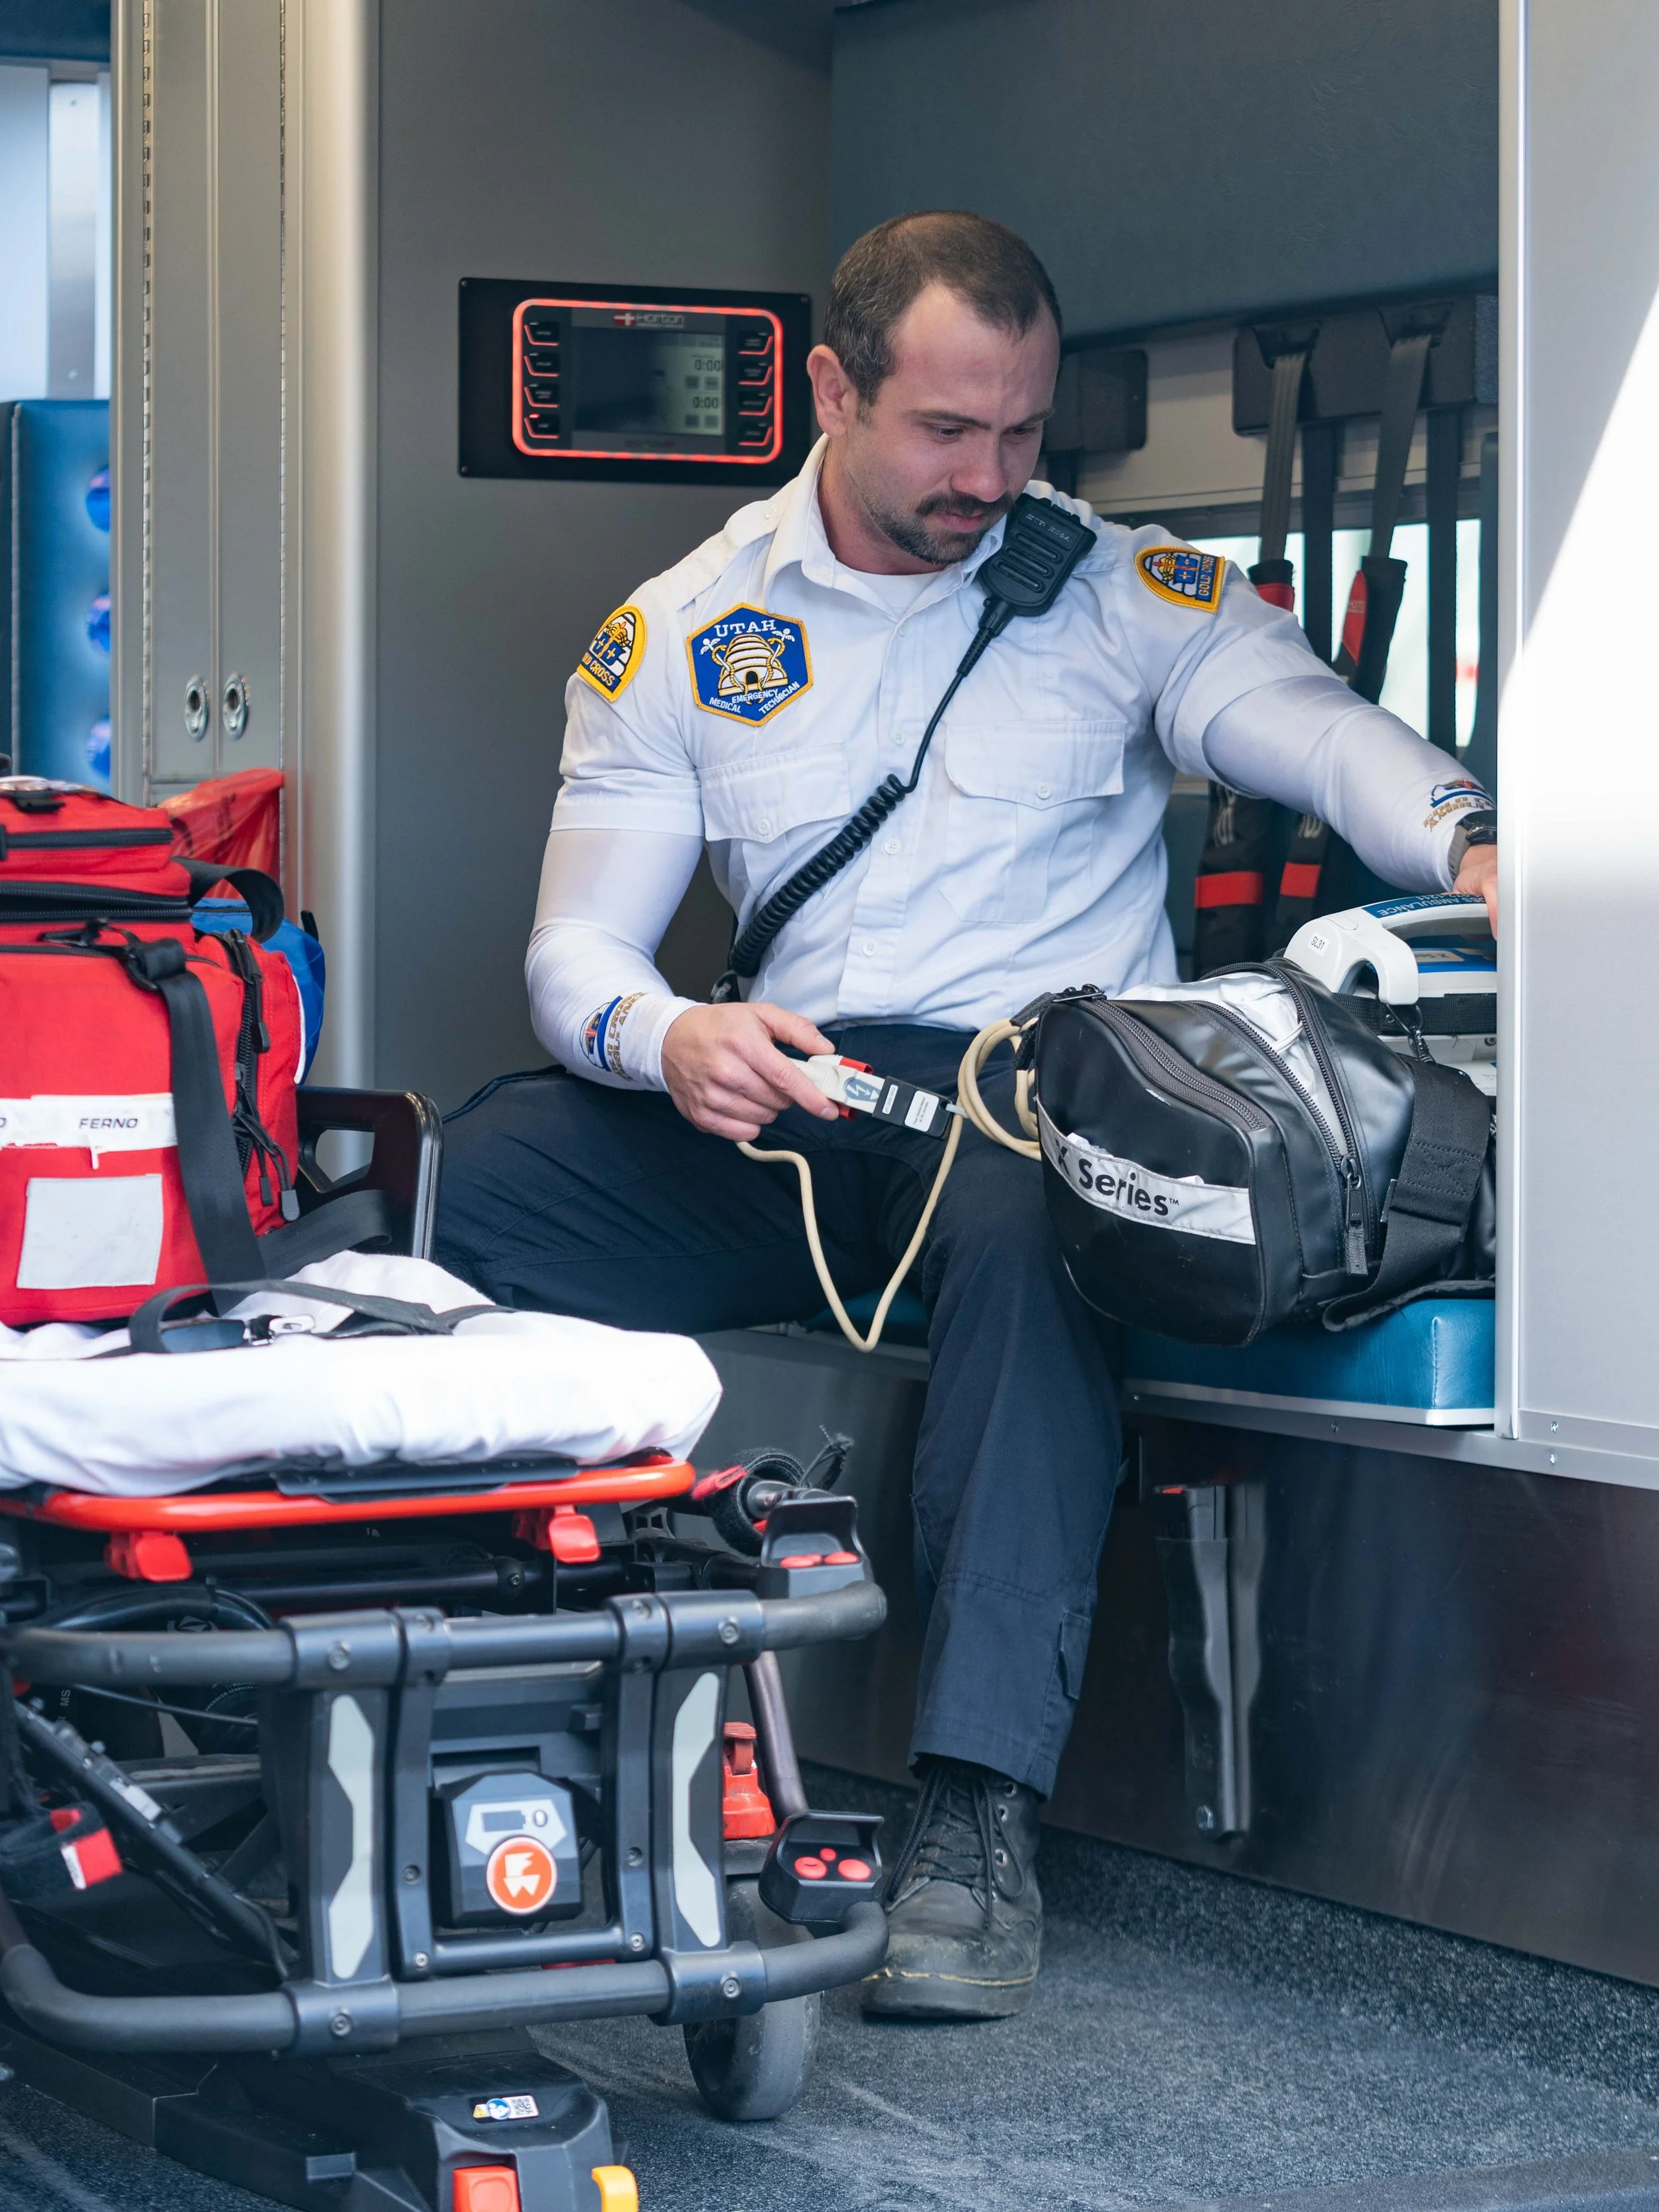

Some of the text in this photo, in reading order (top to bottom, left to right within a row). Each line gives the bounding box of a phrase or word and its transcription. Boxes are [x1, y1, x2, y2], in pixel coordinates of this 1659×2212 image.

[695, 359, 721, 372] 0:00
[692, 397, 719, 409] 0:00
[1198, 575, 1210, 596] GOLD
[714, 620, 776, 637] UTAH
[589, 660, 614, 686] CROSS
[731, 689, 779, 704] EMERGENCY
[758, 681, 800, 714] TECHNICIAN
[709, 697, 741, 713] MEDICAL
[1378, 898, 1459, 916] AMBULANCE
[1311, 936, 1325, 950] SL31
[78, 1118, 138, 1129] FERNO
[1054, 1139, 1070, 1177] X
